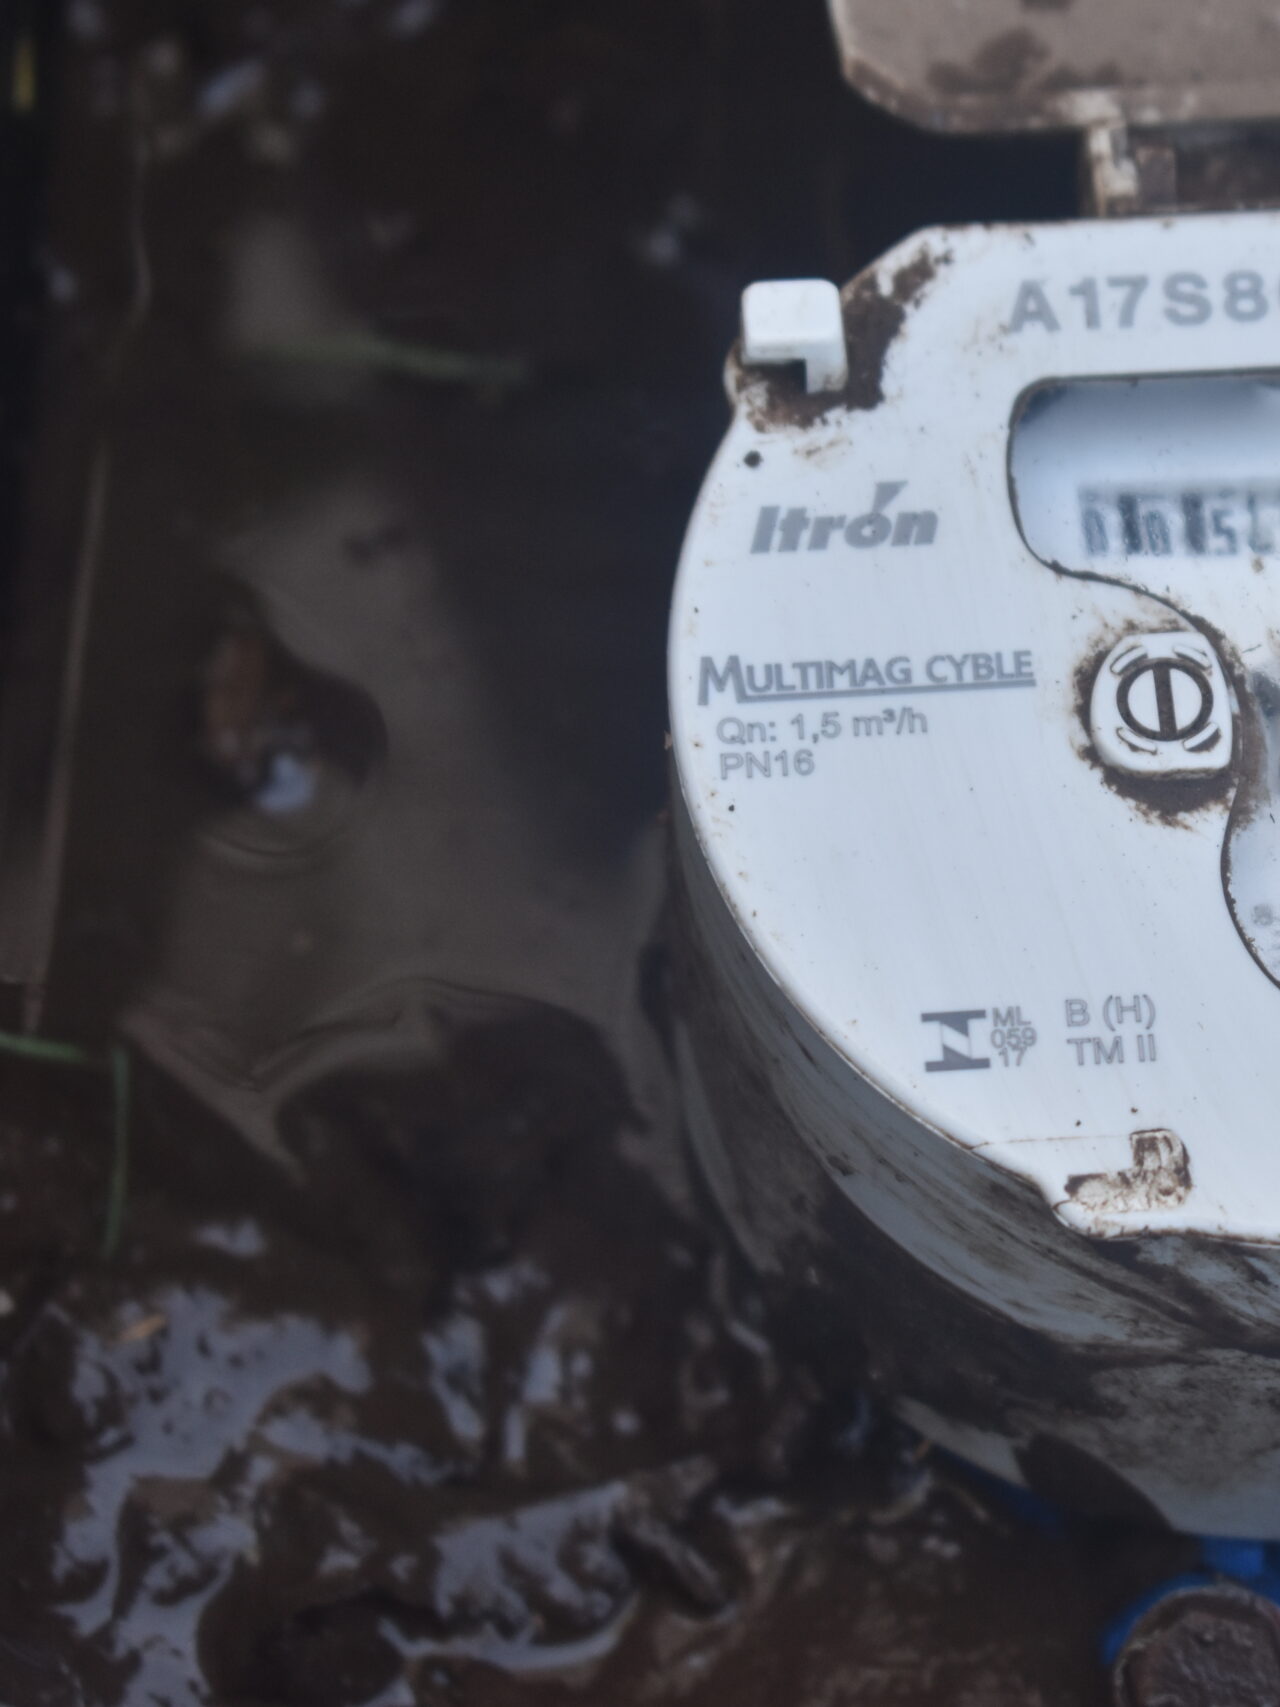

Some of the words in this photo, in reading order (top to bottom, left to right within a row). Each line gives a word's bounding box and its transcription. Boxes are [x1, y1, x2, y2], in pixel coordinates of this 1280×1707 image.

[925, 650, 1036, 684] CYBLE
[716, 716, 777, 745] Qn:
[790, 711, 842, 744] 1,5
[719, 749, 816, 780] PN16
[992, 1005, 1031, 1028] ML
[1065, 998, 1090, 1027] B
[1103, 994, 1156, 1032] (H)
[998, 1046, 1029, 1068] 17
[1066, 1036, 1125, 1066] TM
